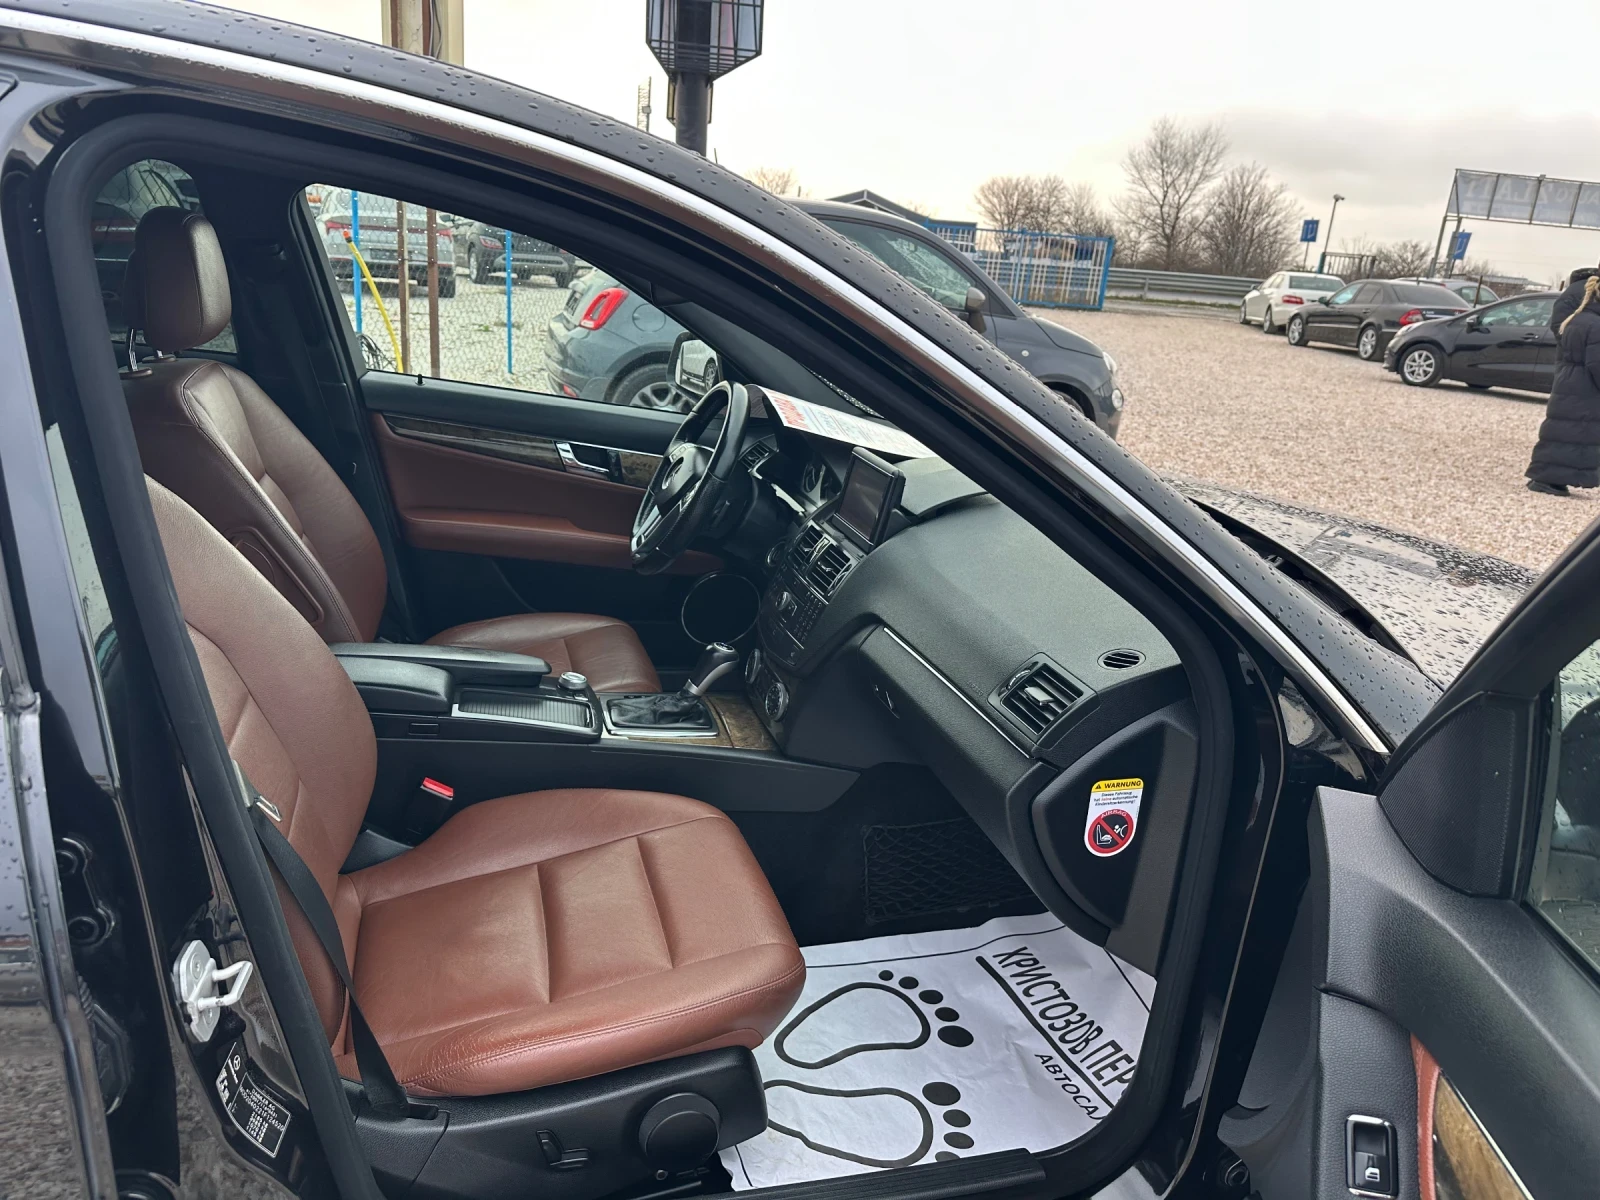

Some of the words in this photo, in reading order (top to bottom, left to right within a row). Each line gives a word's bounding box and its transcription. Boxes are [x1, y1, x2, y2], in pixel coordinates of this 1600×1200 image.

[1104, 780, 1141, 789] WARNUNG
[1101, 809, 1127, 818] AIRBAG
[992, 946, 1104, 1055] ХРИСТОЗОВ
[1080, 1039, 1136, 1095] ПЕР
